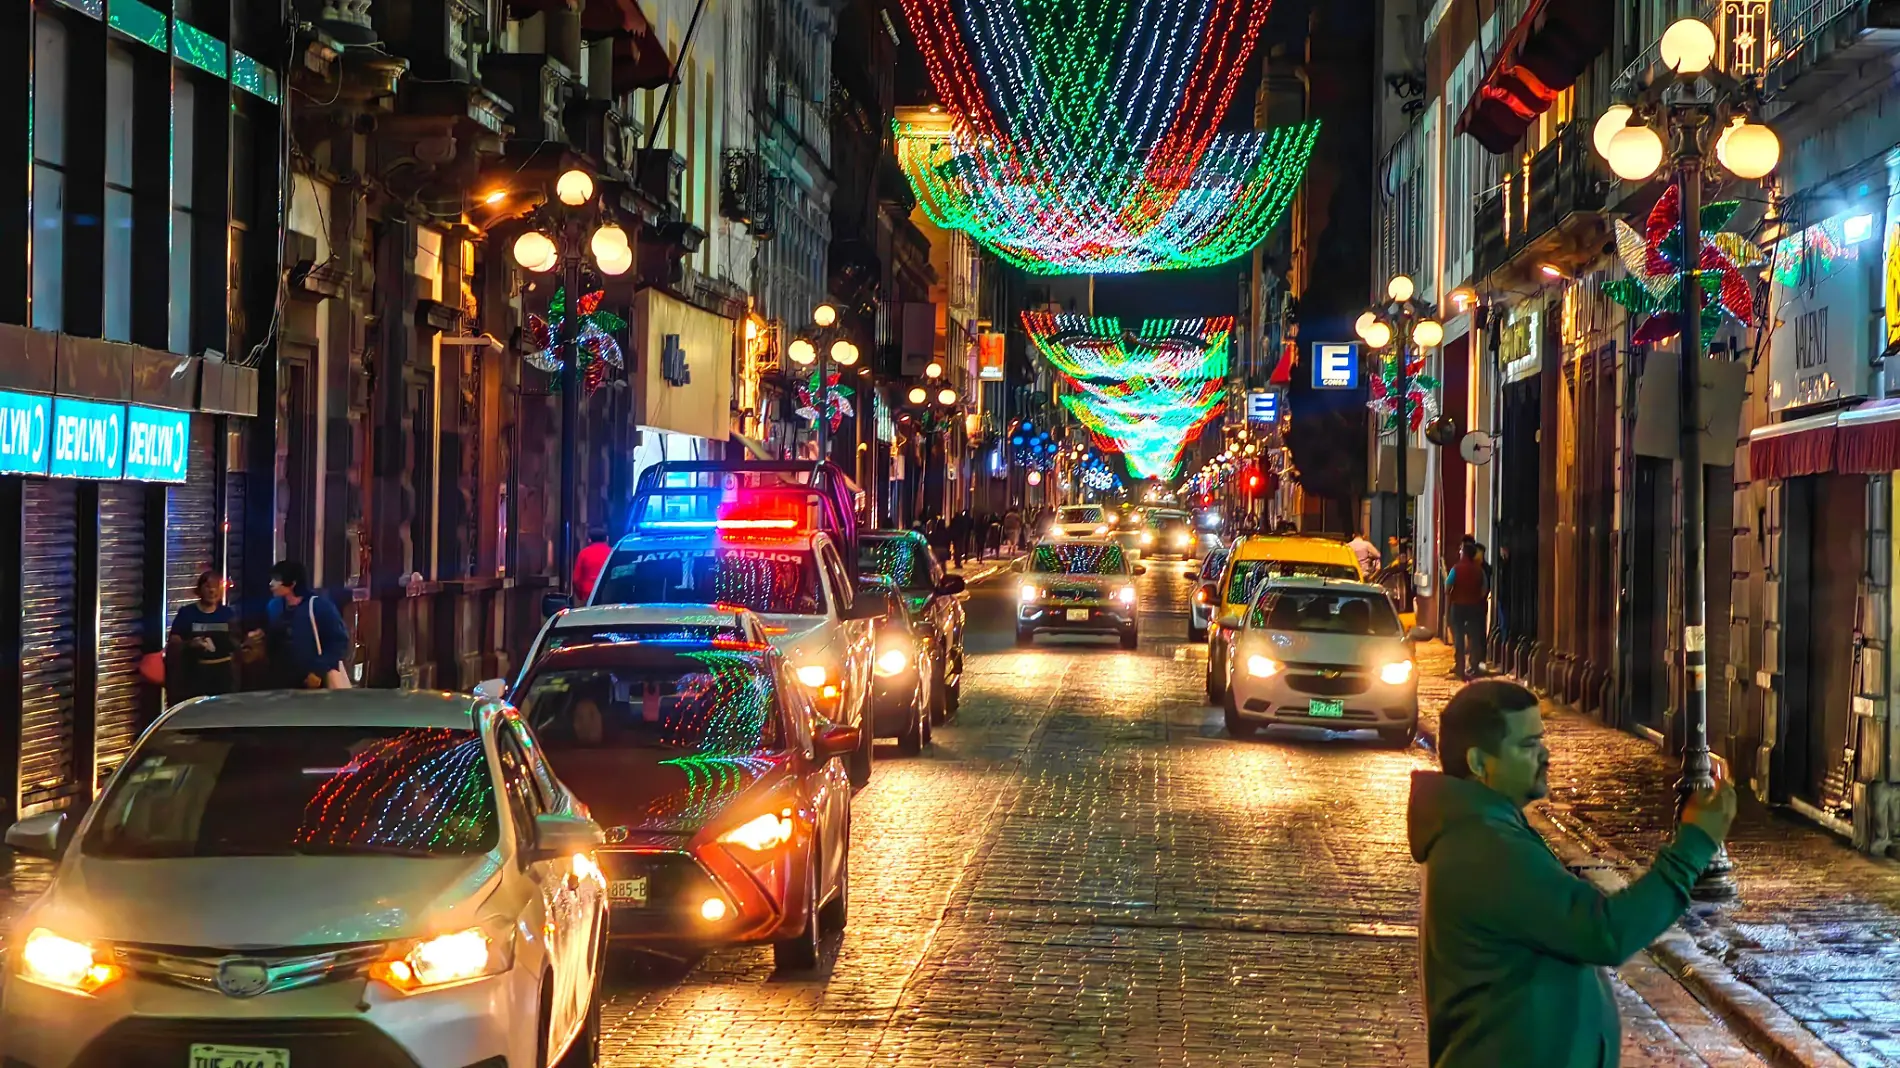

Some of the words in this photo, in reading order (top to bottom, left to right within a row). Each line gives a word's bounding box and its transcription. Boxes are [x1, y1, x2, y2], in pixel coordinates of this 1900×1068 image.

[1794, 306, 1829, 370] VALENTI
[1321, 345, 1350, 380] E
[1248, 393, 1275, 416] E
[56, 415, 107, 463] DEVLYN
[128, 421, 174, 467] DEVLYN
